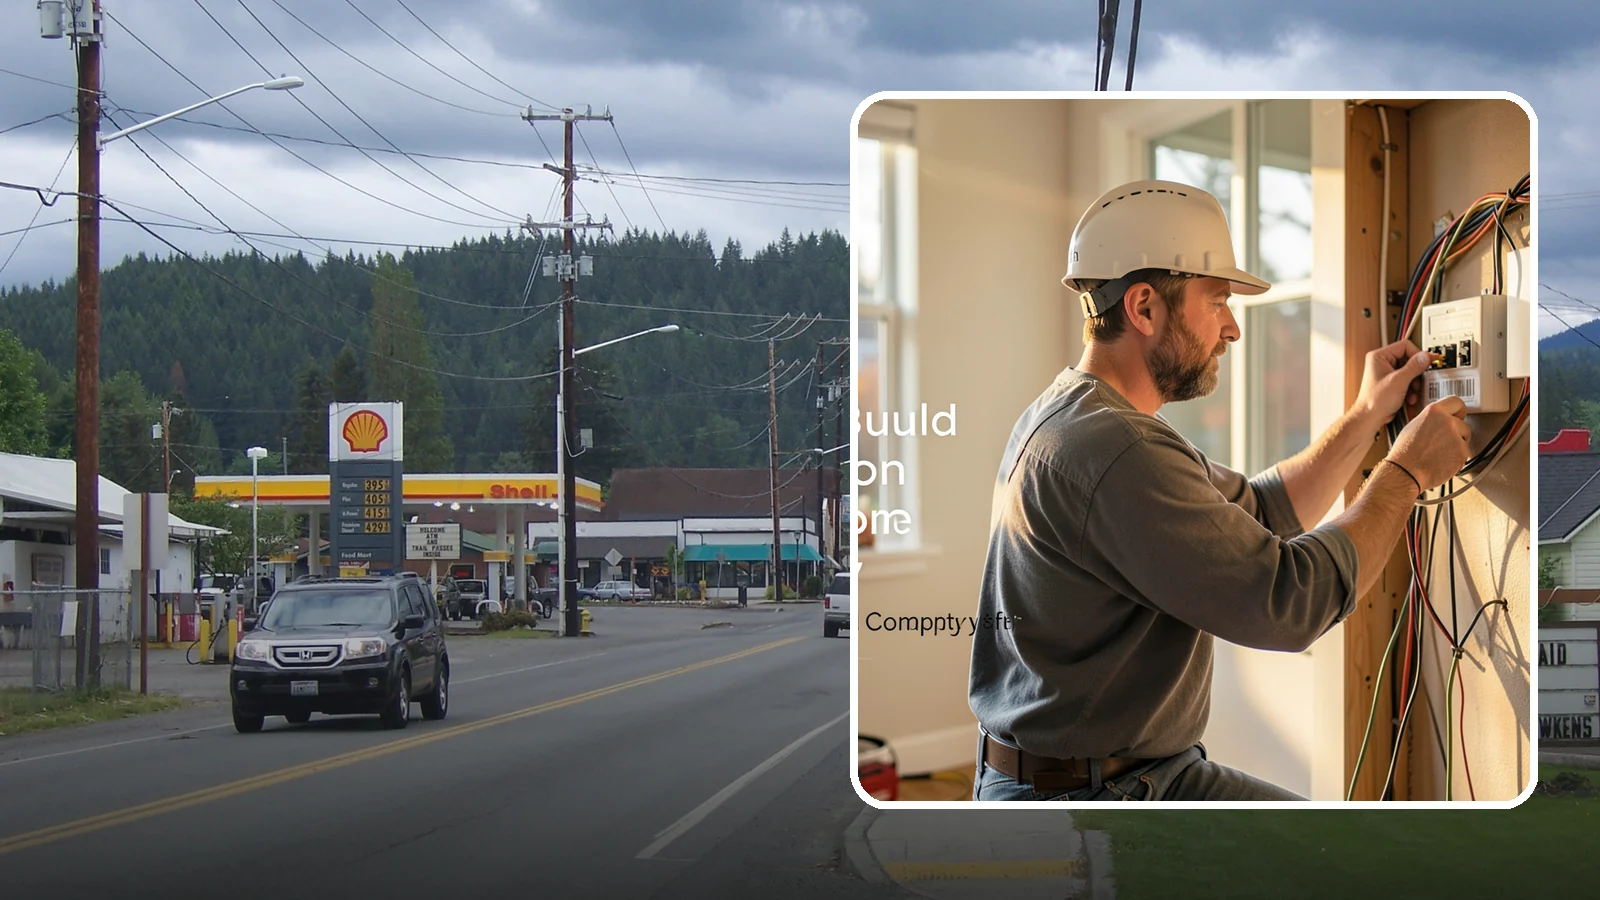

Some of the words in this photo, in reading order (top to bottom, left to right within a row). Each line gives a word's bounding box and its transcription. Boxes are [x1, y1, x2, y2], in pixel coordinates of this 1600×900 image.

[490, 484, 547, 499] Shell
[366, 494, 383, 504] 405
[366, 508, 383, 518] 415
